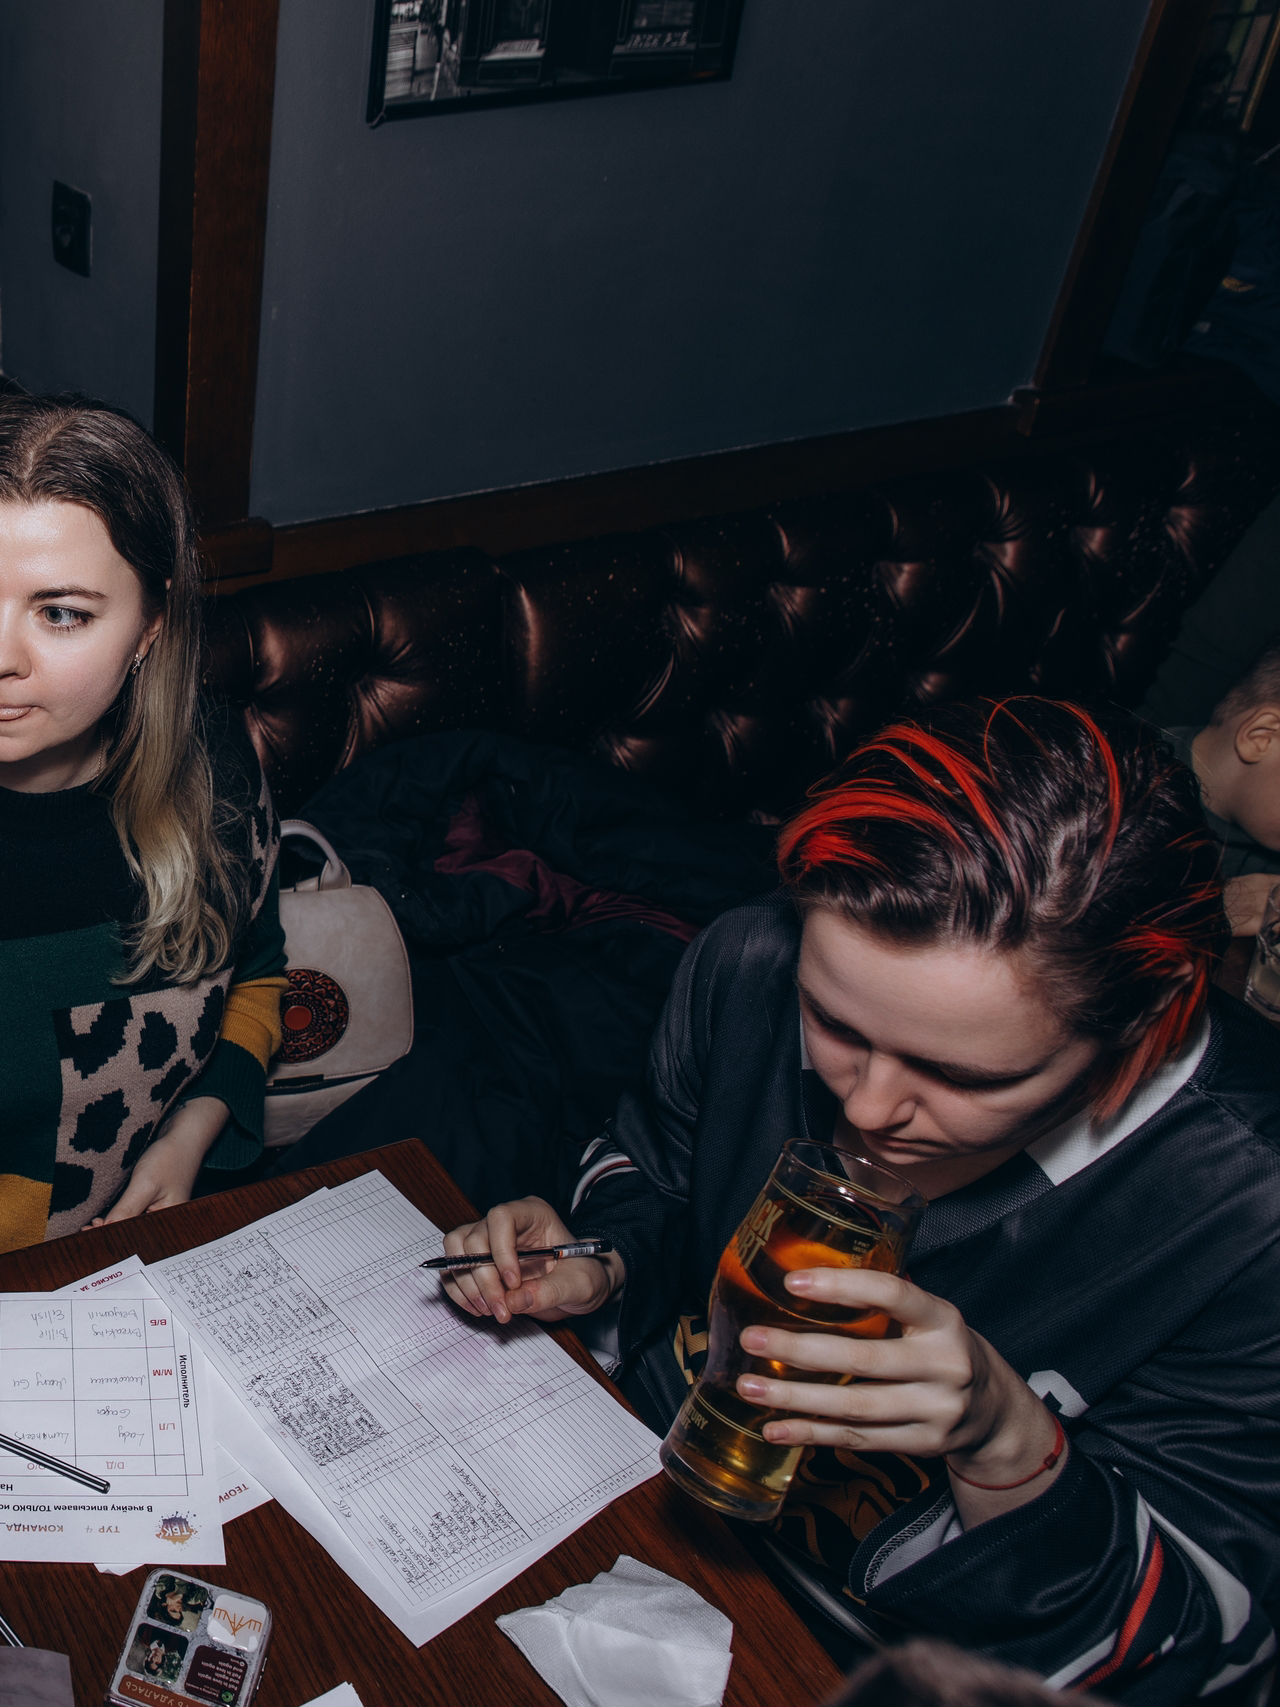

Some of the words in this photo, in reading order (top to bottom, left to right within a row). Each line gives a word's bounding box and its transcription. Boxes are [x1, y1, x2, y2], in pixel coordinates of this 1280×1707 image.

[178, 1355, 190, 1409] Исполнитель
[118, 1425, 145, 1446] Lady
[12, 1504, 52, 1512] ТОЛЬКО
[111, 1504, 144, 1513] ячейку
[147, 1505, 153, 1513] В
[5, 1523, 64, 1533] КОМАНДА
[84, 1525, 93, 1534] 4
[98, 1525, 121, 1534] ТУР
[375, 1535, 399, 1563] Walker
[200, 1660, 216, 1669] again
[217, 1660, 233, 1669] again
[232, 1665, 243, 1673] and
[214, 1666, 226, 1674] love
[196, 1671, 212, 1680] again
[213, 1671, 229, 1680] again
[230, 1671, 241, 1679] Fall
[211, 1677, 223, 1685] love
[123, 1680, 174, 1705] УДАЛАСЬ
